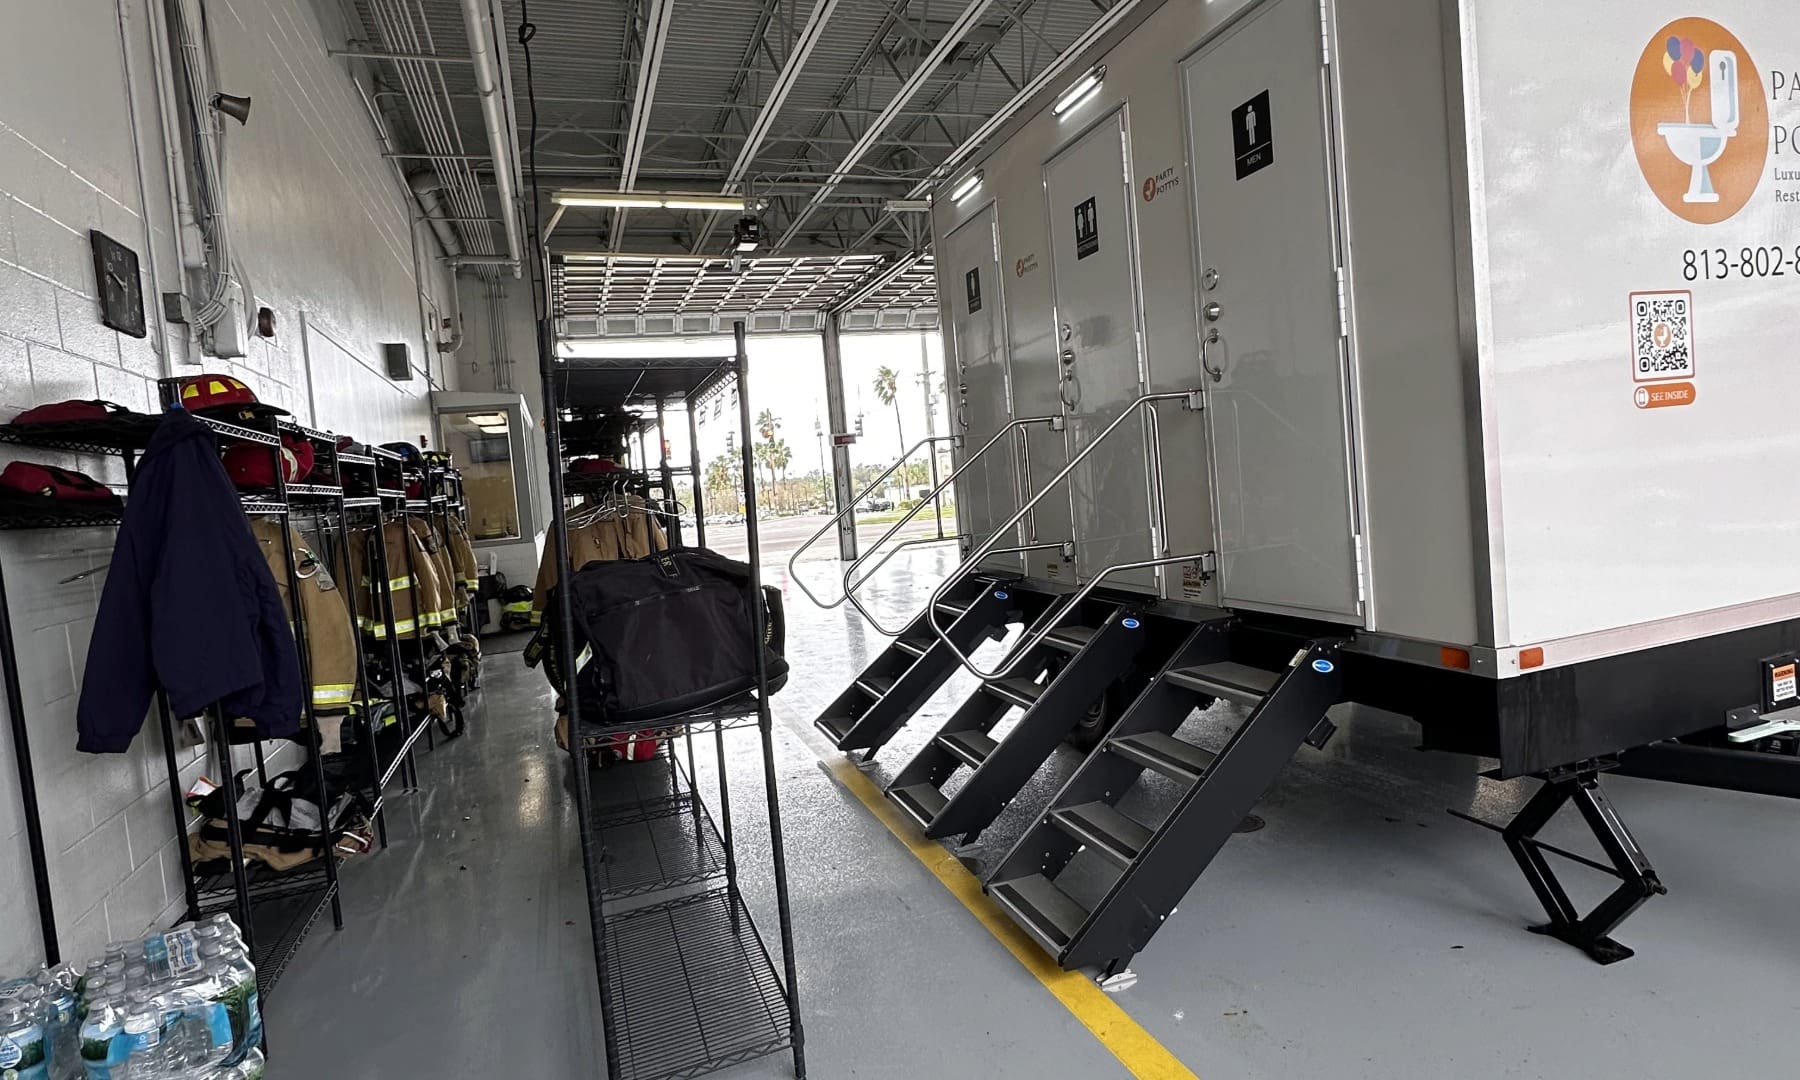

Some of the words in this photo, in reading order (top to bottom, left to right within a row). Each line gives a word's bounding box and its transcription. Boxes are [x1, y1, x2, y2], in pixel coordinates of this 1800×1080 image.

[1774, 167, 1800, 181] Luxu
[1775, 189, 1800, 202] Rest
[1651, 391, 1664, 401] SEE
[1665, 389, 1688, 400] INSIDE
